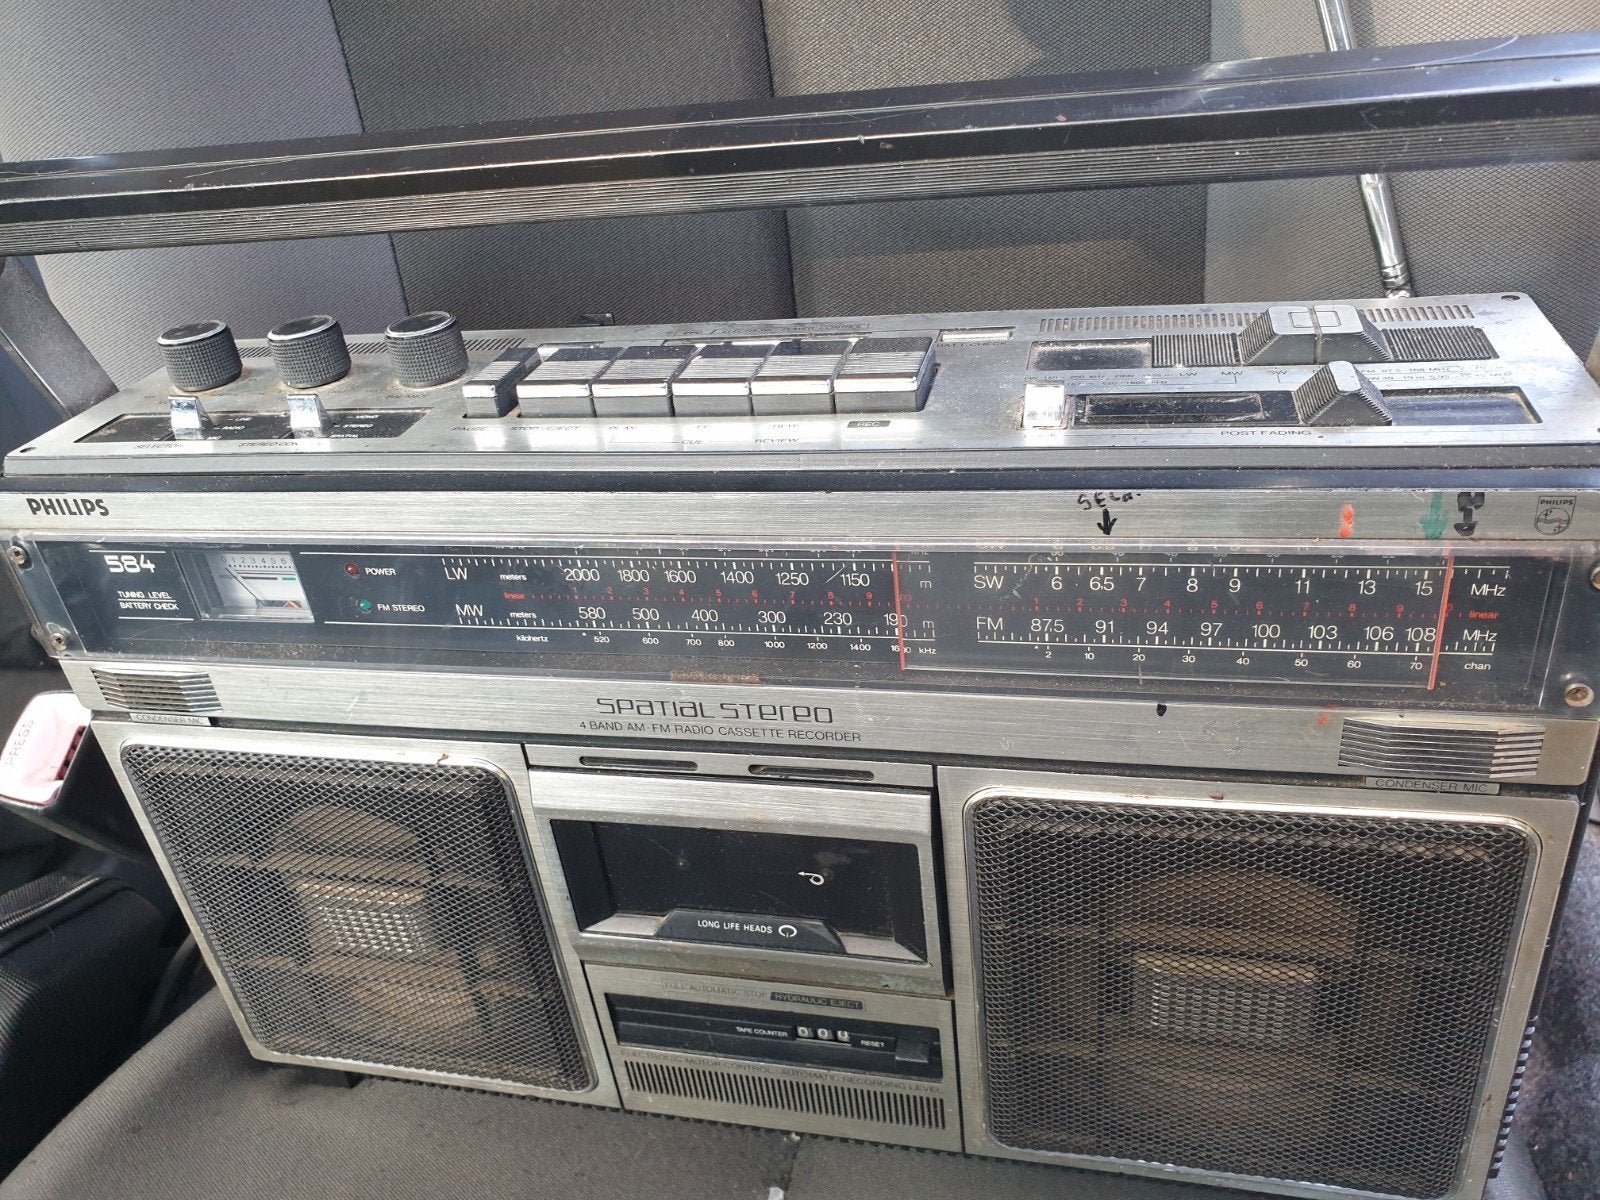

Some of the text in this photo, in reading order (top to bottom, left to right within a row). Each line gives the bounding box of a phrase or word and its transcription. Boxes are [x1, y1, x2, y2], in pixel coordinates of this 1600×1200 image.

[26, 498, 109, 516] PHILIPS
[104, 554, 155, 573] 584
[365, 567, 396, 576] POWER
[445, 567, 932, 589] LW meters 2000 1800 1600 1400 1250 1150 m
[974, 575, 1004, 589] SW
[1051, 577, 1062, 590] 6
[1137, 577, 1146, 591] 7
[1186, 578, 1198, 592] 8
[1229, 578, 1240, 592] 9
[1295, 580, 1310, 594] 11
[1359, 580, 1376, 594] 13
[1415, 581, 1433, 596] 15
[1471, 583, 1506, 596] MHz
[117, 591, 172, 599] TUNING LEVEL
[715, 589, 721, 597] 5
[752, 589, 758, 597] 6
[120, 602, 152, 610] BATTERY
[377, 603, 425, 612] FM STEREO
[1120, 599, 1127, 607] 3
[1255, 601, 1263, 610] 6
[1303, 602, 1310, 610] 7
[1349, 603, 1357, 611] 8
[1396, 604, 1404, 612] 9
[1469, 610, 1499, 619] linear
[455, 604, 935, 629] MW meters 580 500 400 300 230 190 m
[976, 616, 1003, 631] FM
[1095, 620, 1115, 633] 91
[1146, 621, 1169, 635] 94
[1200, 622, 1223, 637] 97
[1252, 624, 1281, 638] 100
[1308, 625, 1338, 640] 103
[1364, 626, 1394, 641] 106
[1405, 627, 1436, 642] 108
[1463, 629, 1498, 642] MHz
[516, 634, 549, 643] kilohertz
[642, 637, 659, 645] 600
[685, 638, 702, 647] 700
[717, 639, 735, 647] 800
[764, 640, 785, 649] 1000
[807, 642, 828, 650] 1200
[850, 643, 871, 651] 1400
[919, 647, 936, 655] kHz
[1045, 651, 1491, 670] 2 10 20 30 40 50 60 70 chan
[137, 714, 204, 725] CONDENSER MIC
[579, 721, 587, 730] 4
[590, 721, 623, 731] BAND
[675, 724, 714, 735] RADIO
[718, 726, 784, 738] CASSETTE
[788, 729, 861, 742] RECORDER
[1375, 778, 1488, 792] CONDENSER MIC
[697, 920, 772, 933] LONG LIFE HEADS
[689, 984, 737, 994] AUTOMATIC
[746, 989, 767, 998] STOP
[774, 992, 860, 1009] HYDRAULIC EJECT
[736, 1026, 788, 1037] TAPE COUNTER
[861, 1039, 885, 1047] RESET
[685, 1057, 721, 1067] MOTOR
[723, 1062, 772, 1073] CONTROL
[781, 1069, 942, 1095] AUTOMATIC RECORDING LEVEL
